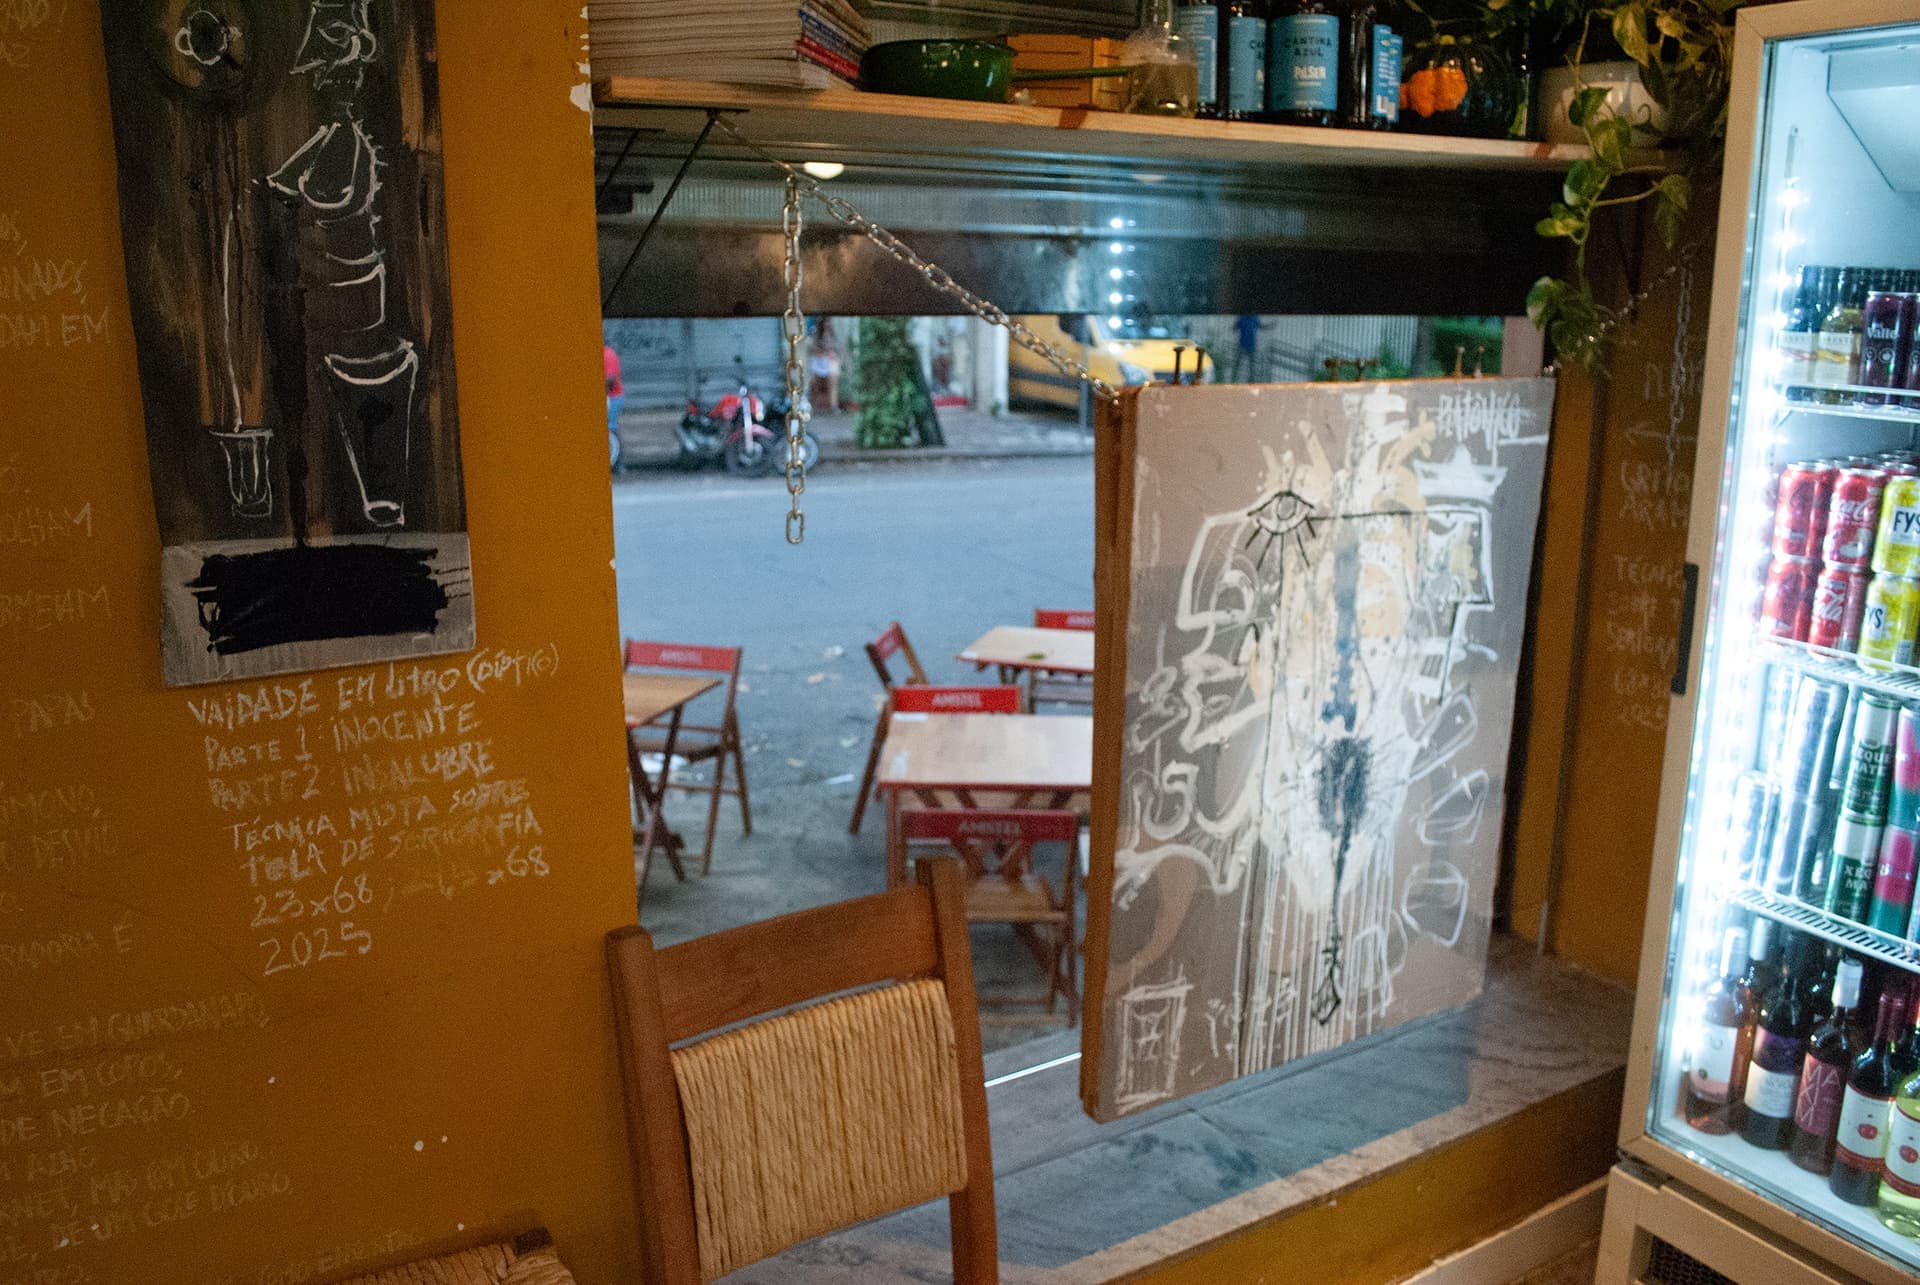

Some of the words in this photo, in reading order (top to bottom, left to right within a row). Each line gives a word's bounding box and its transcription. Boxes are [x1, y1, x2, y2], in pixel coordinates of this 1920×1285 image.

[60, 306, 111, 346] EM
[337, 671, 376, 712] EM
[331, 690, 482, 754] INOCENTE
[340, 834, 376, 868] DE
[259, 921, 373, 977] 2025
[40, 1066, 91, 1098] EM
